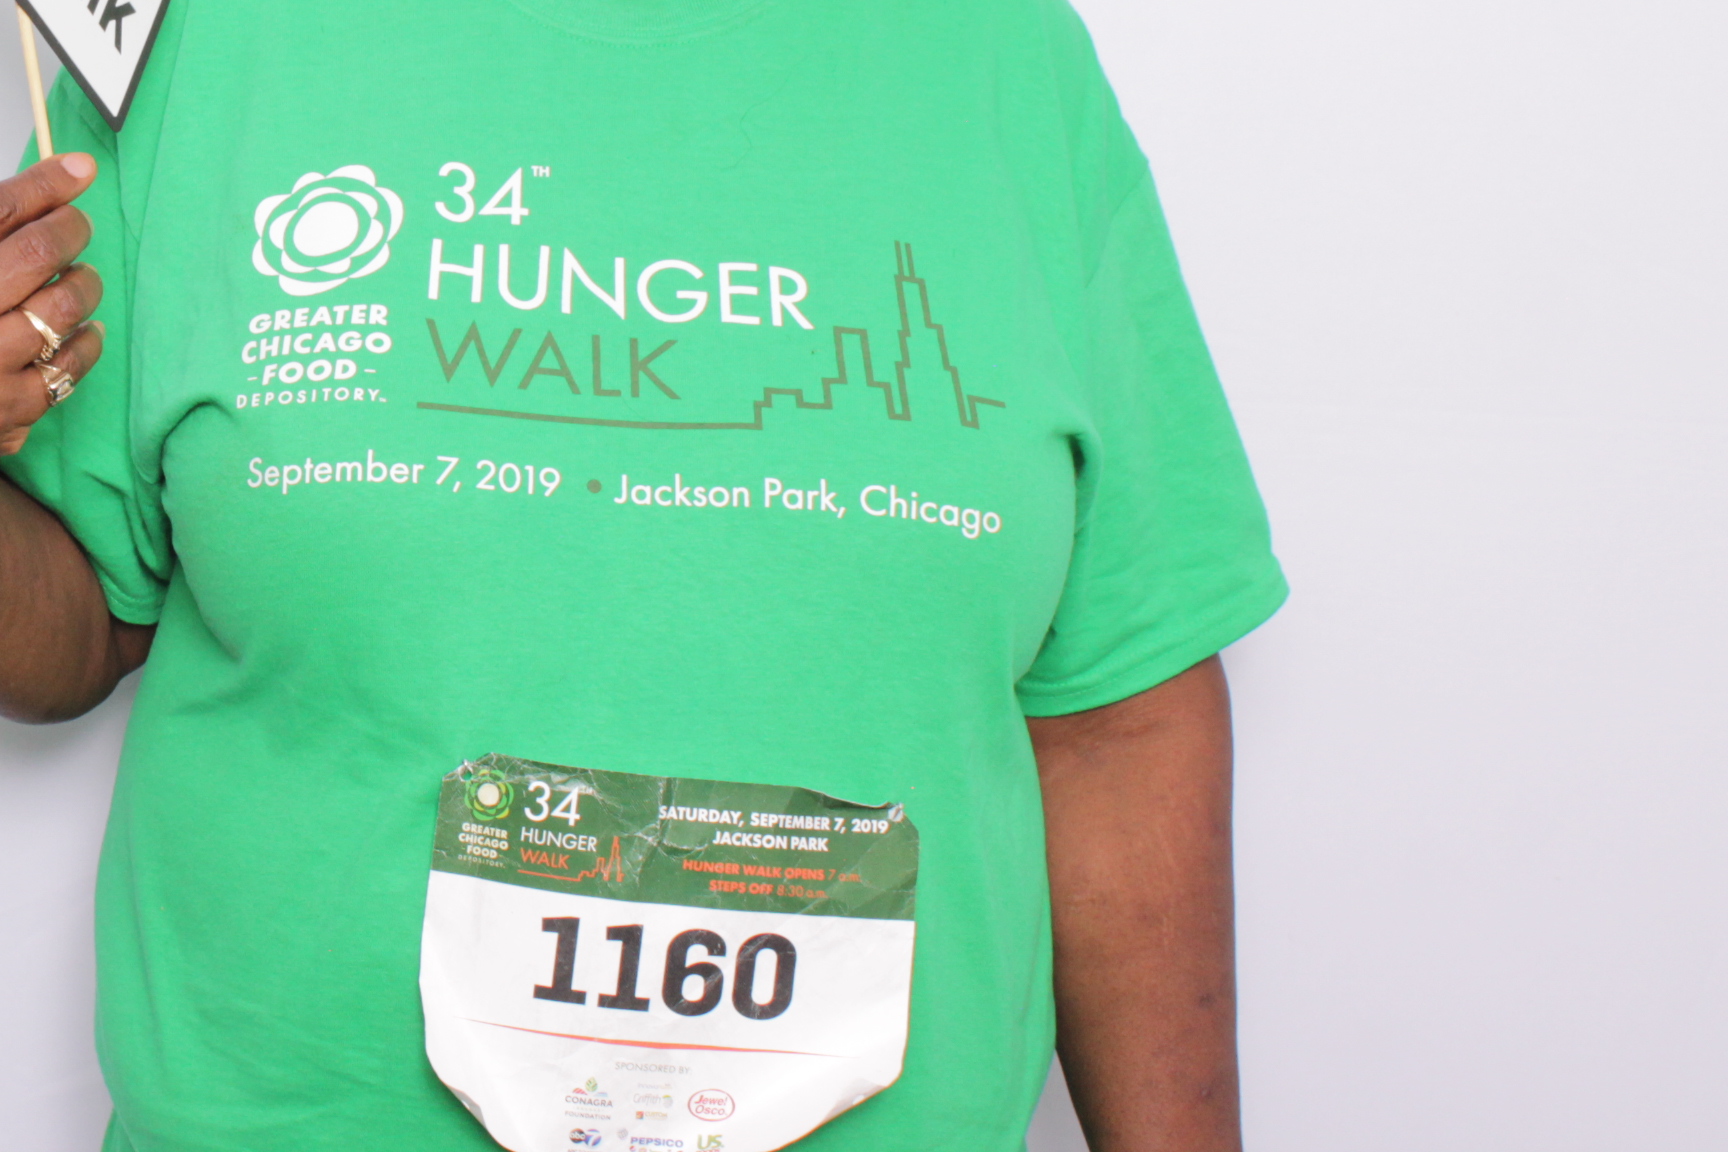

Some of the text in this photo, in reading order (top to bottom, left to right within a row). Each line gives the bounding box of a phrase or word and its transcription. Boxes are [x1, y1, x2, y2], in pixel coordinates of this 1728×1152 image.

[427, 237, 815, 330] HUNGER
[248, 303, 389, 335] GREATER
[241, 330, 393, 365] CHICAGO
[425, 317, 683, 400] WALK
[247, 449, 563, 498] September 7, 2019
[613, 473, 1002, 539] Jackson Park, Chicago
[461, 822, 509, 840] GREATER
[658, 805, 890, 835] SATURDAY, SEPTEMBER 7, 2019
[458, 832, 509, 851] CHICAGO
[520, 826, 598, 853] HUNGER
[712, 831, 830, 852] JACKSON PARK
[520, 847, 571, 870] WALK
[682, 859, 740, 875] HUNGER
[743, 864, 782, 879] WALK
[785, 867, 826, 881] OPENS
[828, 868, 837, 881] 7
[709, 879, 747, 894] STEPS
[749, 882, 774, 895] OFF
[776, 884, 804, 898] 8:30
[533, 915, 798, 1021] 1160
[615, 1061, 676, 1074] SPONSORED
[565, 1095, 614, 1108] CONAGRA
[565, 1110, 612, 1121] FOUNDATION
[630, 1136, 684, 1148] PEPSICO
